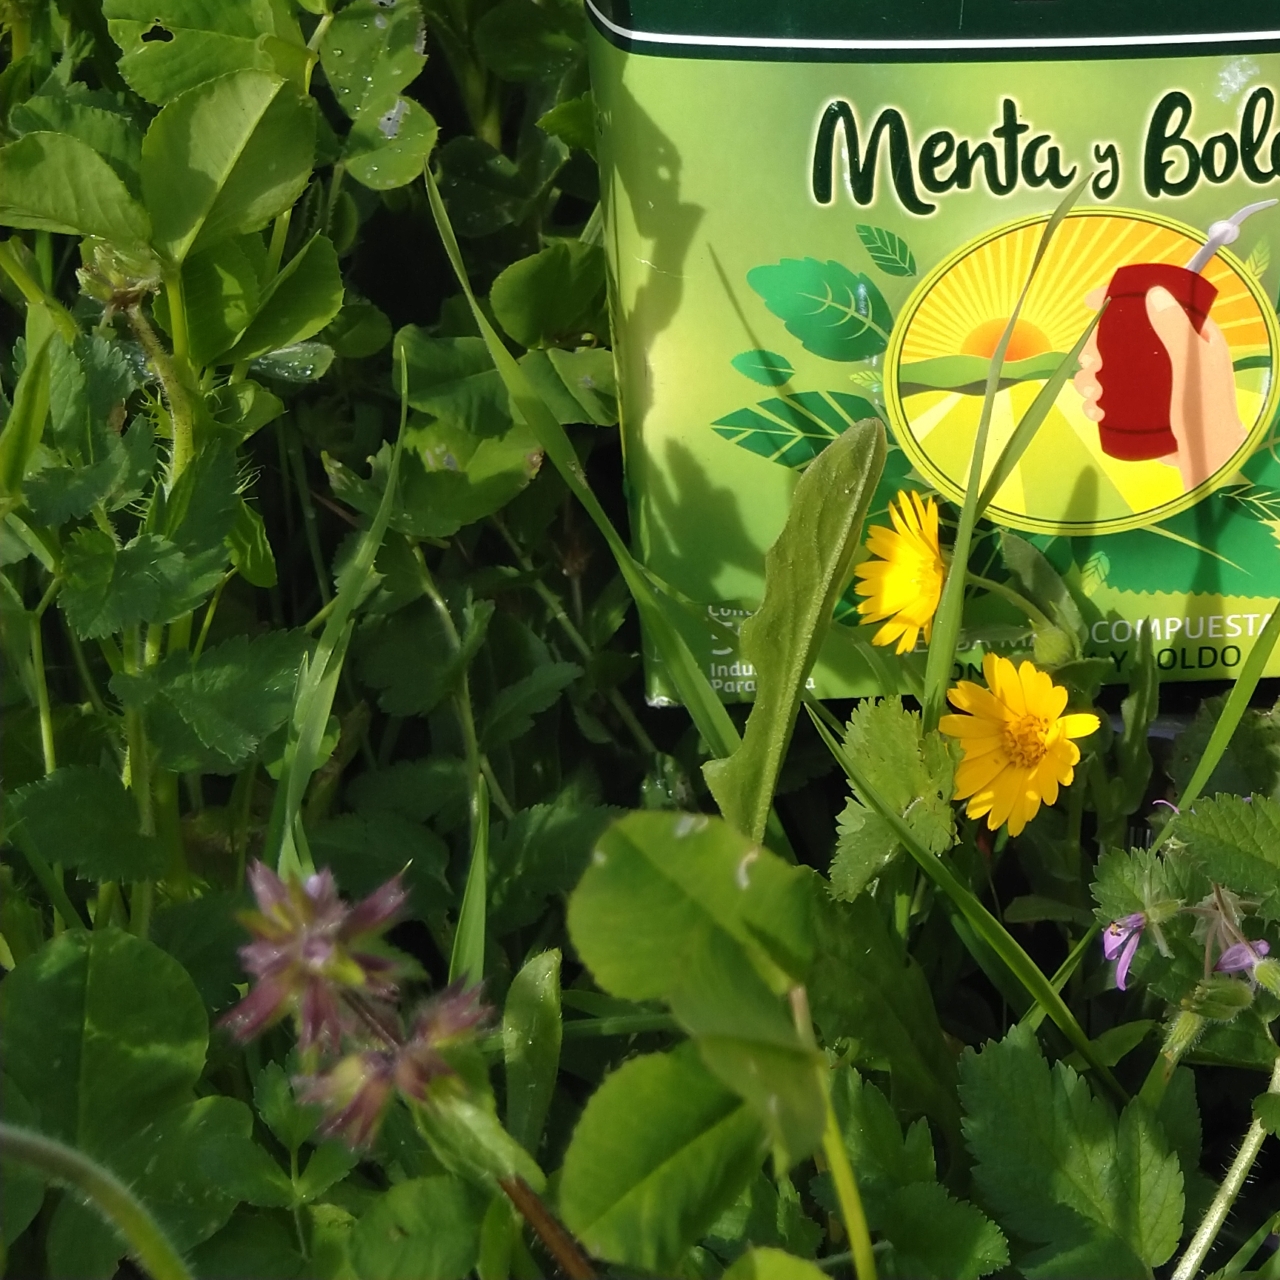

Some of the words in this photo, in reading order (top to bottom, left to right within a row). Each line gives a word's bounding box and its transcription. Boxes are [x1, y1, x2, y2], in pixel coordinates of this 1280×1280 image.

[812, 99, 1076, 217] Menta
[1091, 142, 1121, 202] y
[1110, 650, 1129, 672] Y
[1157, 645, 1242, 671] OLDO
